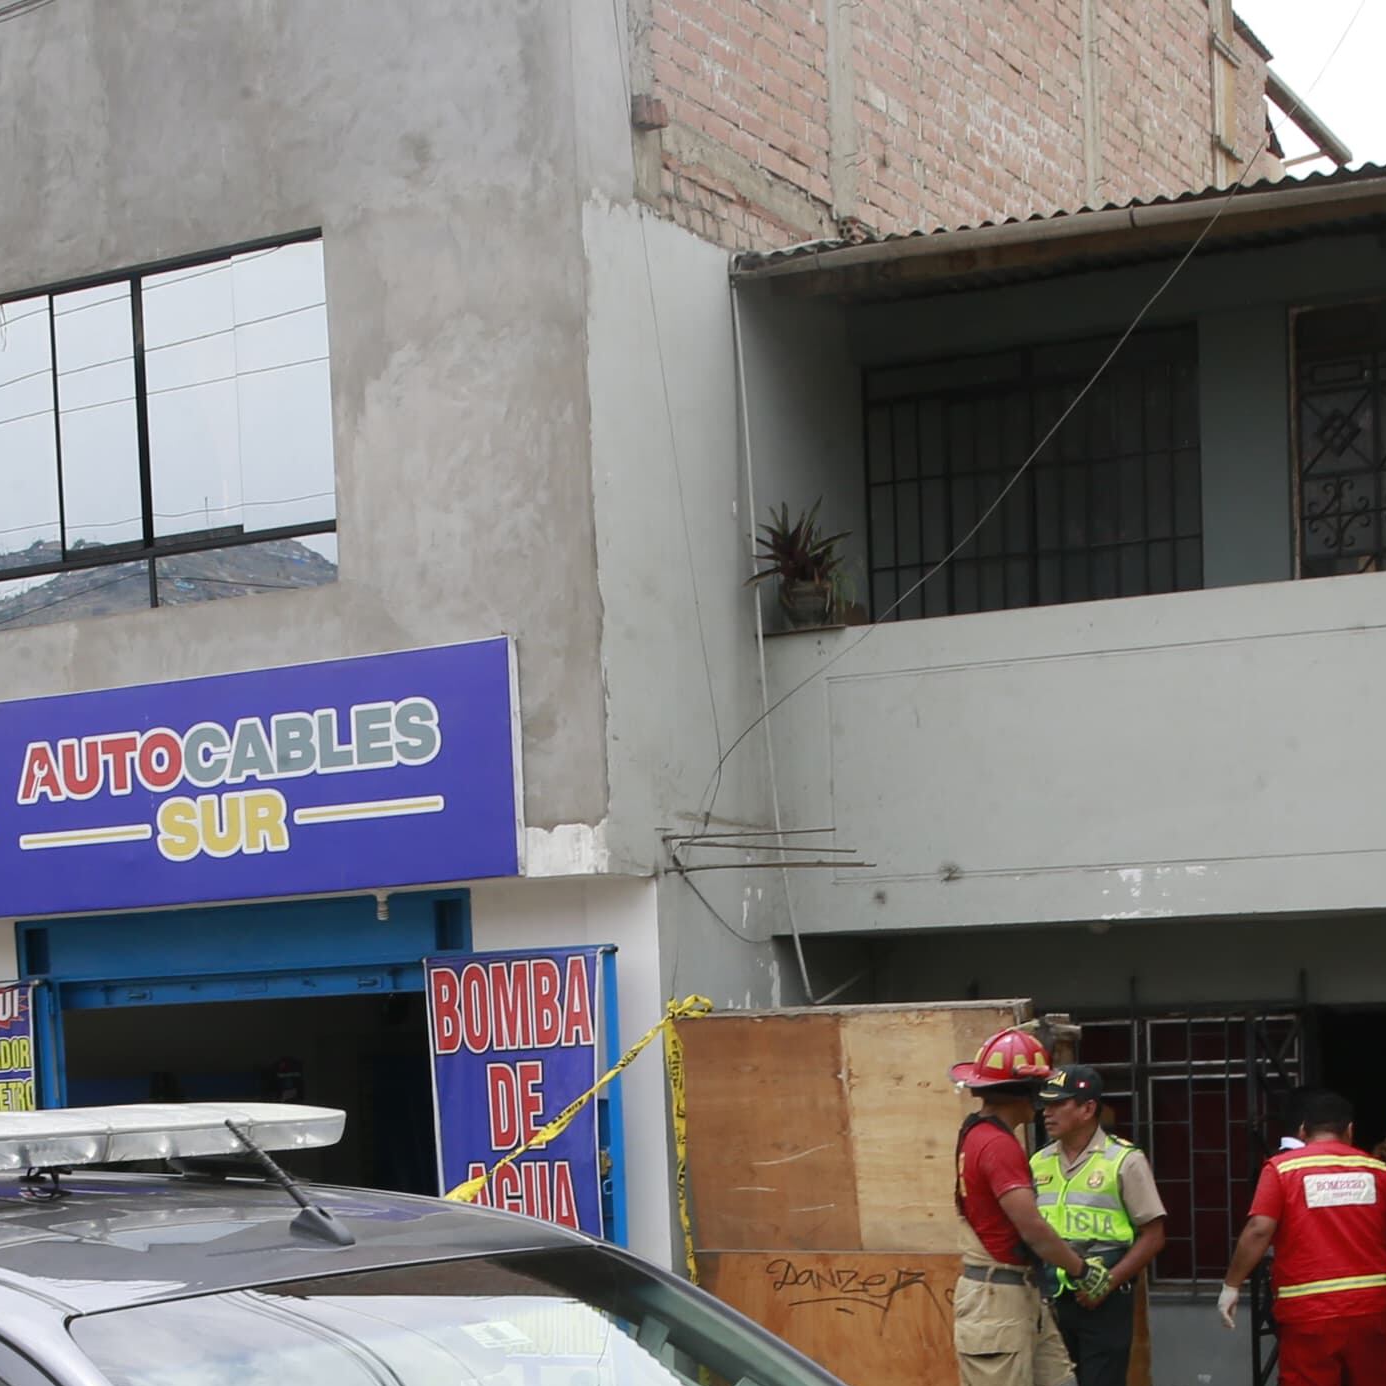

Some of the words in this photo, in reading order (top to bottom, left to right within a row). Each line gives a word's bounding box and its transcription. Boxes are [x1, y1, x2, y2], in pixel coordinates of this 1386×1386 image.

[16, 696, 441, 804] AUTOCABLES
[157, 789, 290, 862] SUR
[430, 956, 595, 1055] BOMBA
[487, 1061, 547, 1150] DE
[1045, 1208, 1116, 1235] ICIA
